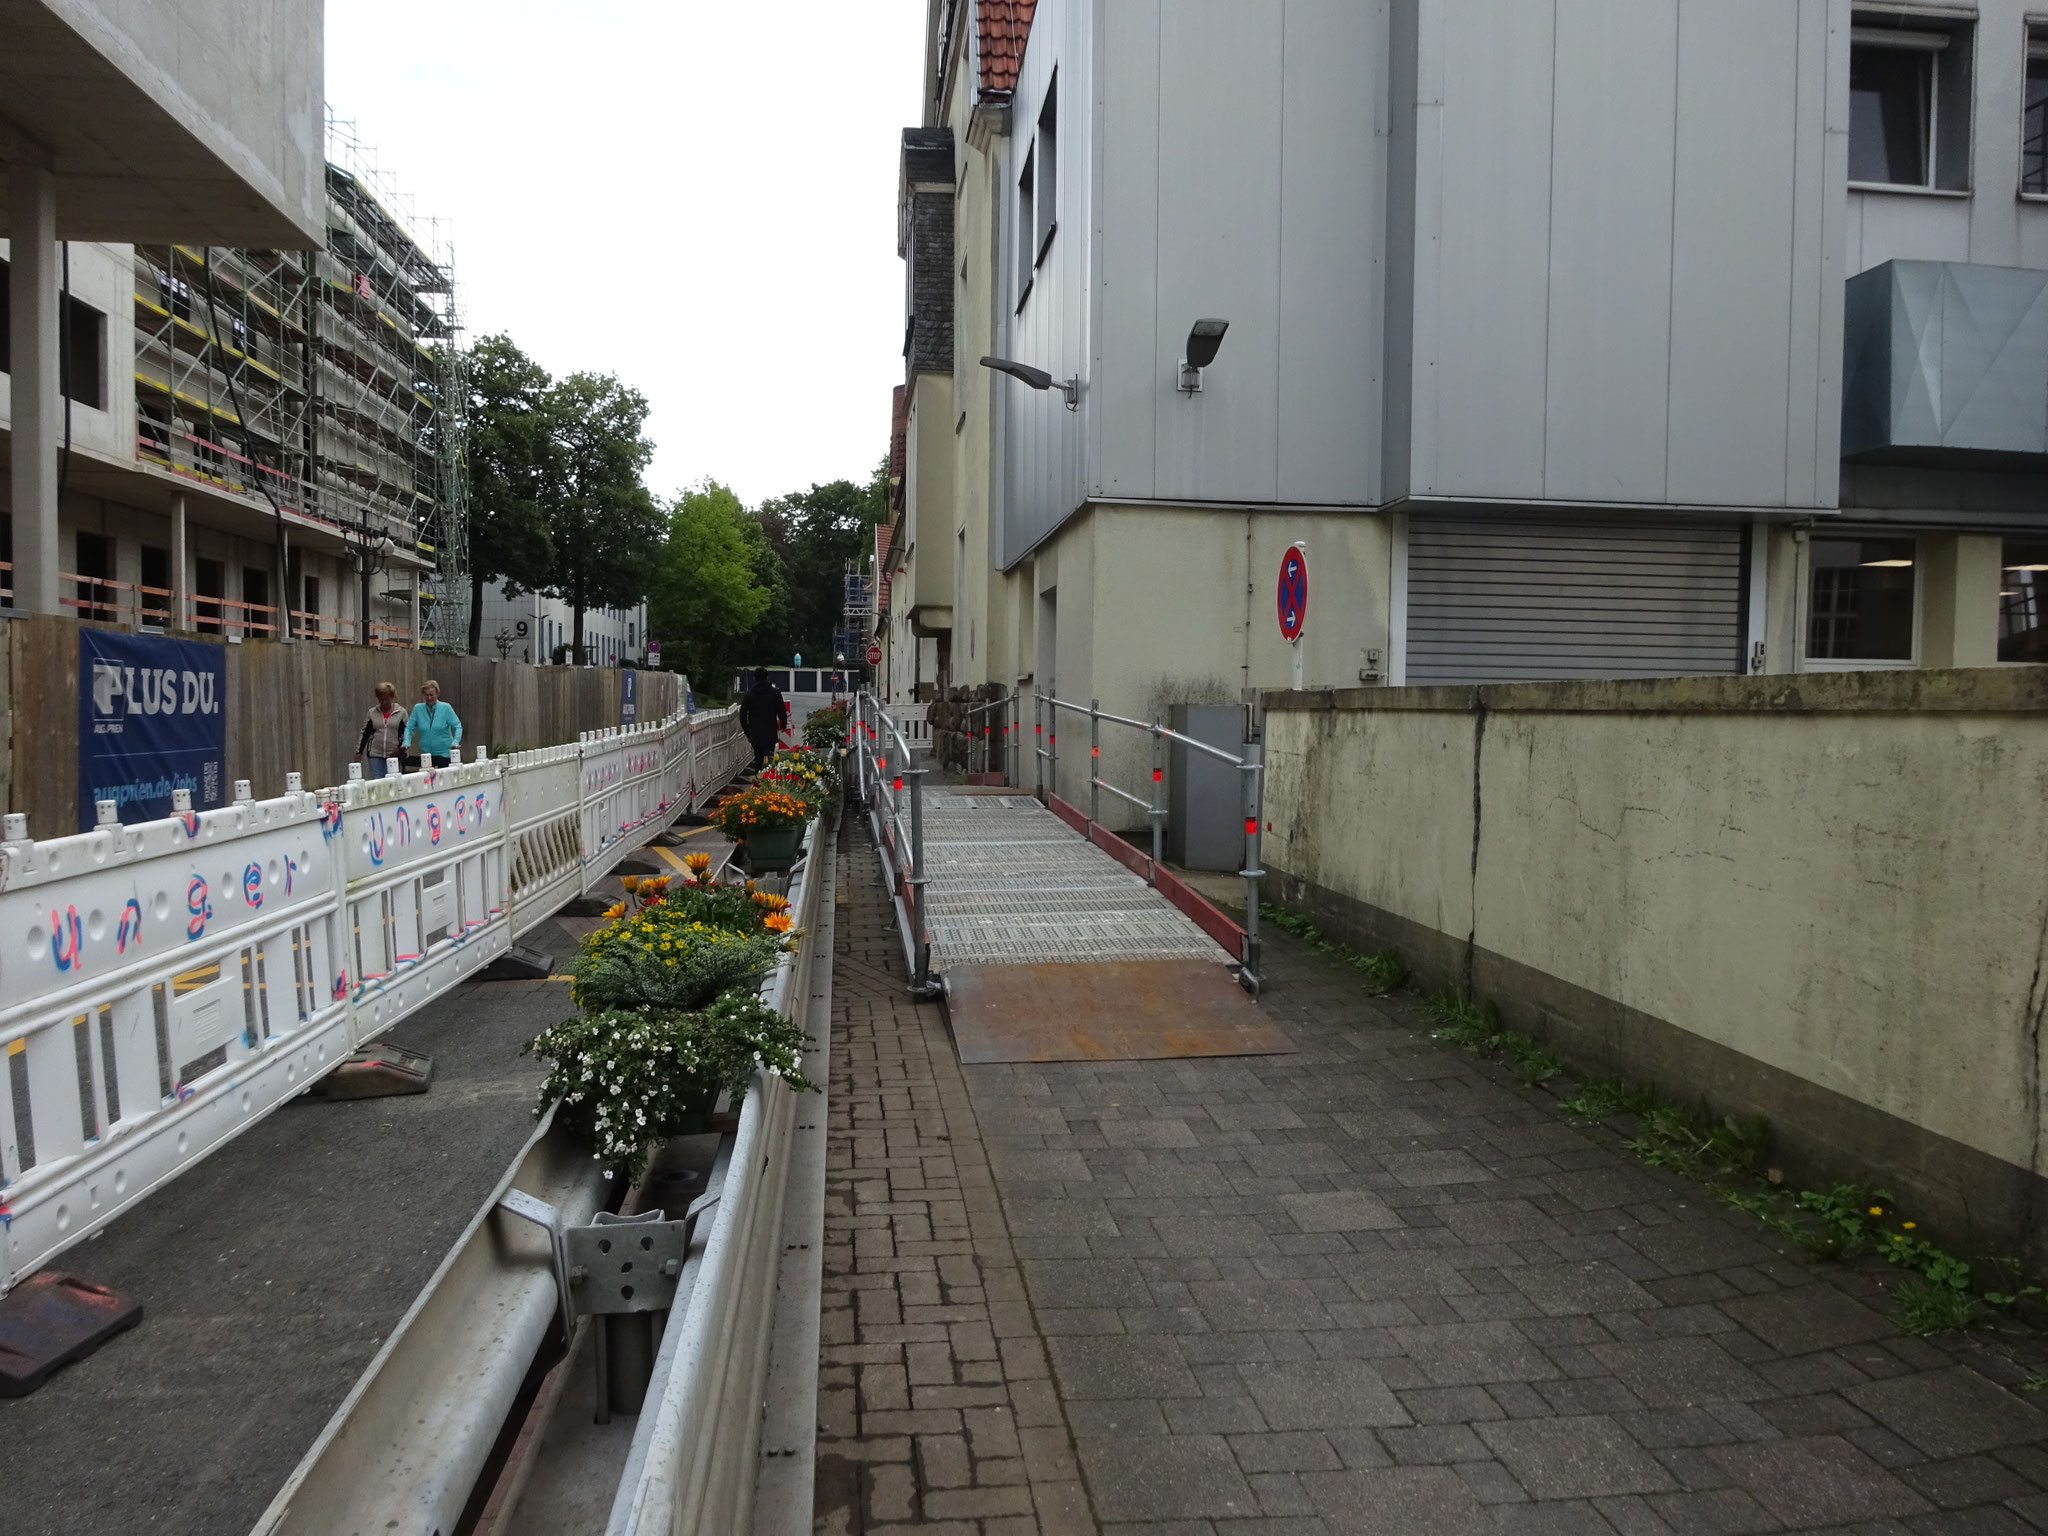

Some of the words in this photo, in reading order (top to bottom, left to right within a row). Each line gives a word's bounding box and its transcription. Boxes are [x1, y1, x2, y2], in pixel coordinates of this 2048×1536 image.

[516, 621, 528, 637] 9
[868, 652, 880, 660] STOP
[93, 664, 177, 715] PLUS
[182, 670, 219, 714] DU.
